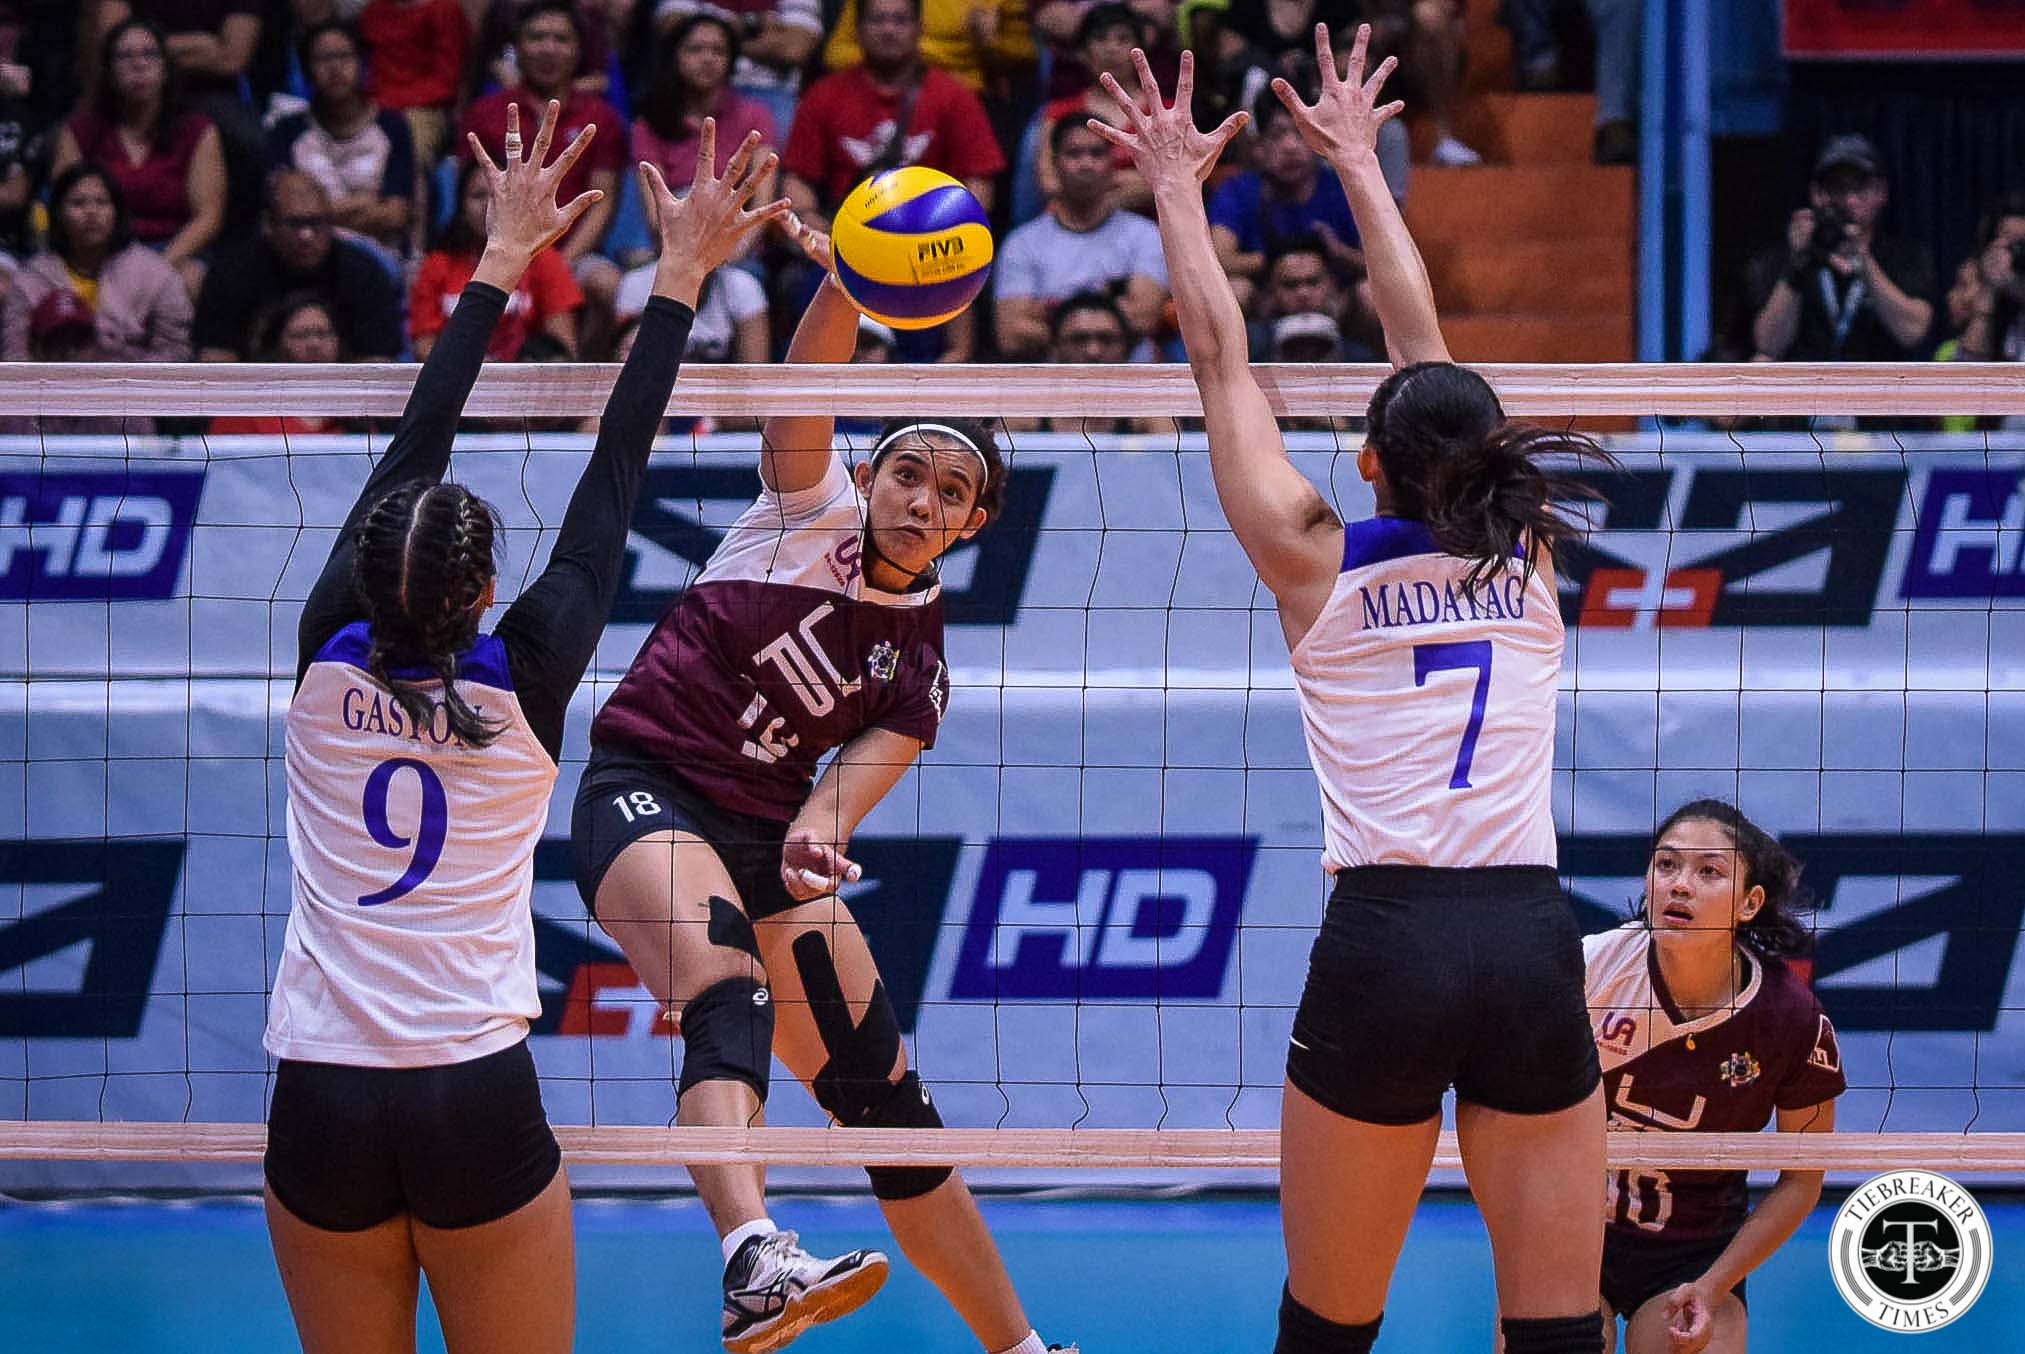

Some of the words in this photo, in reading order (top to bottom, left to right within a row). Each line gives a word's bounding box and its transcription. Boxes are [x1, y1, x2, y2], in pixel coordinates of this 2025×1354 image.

[0, 496, 173, 577] HD
[1928, 493, 2025, 575] H
[1359, 575, 1525, 630] MADAYAG
[342, 687, 482, 748] GASO
[1412, 640, 1493, 790] 7
[357, 757, 448, 906] 9
[612, 791, 662, 823] 18
[985, 868, 1217, 968] HD
